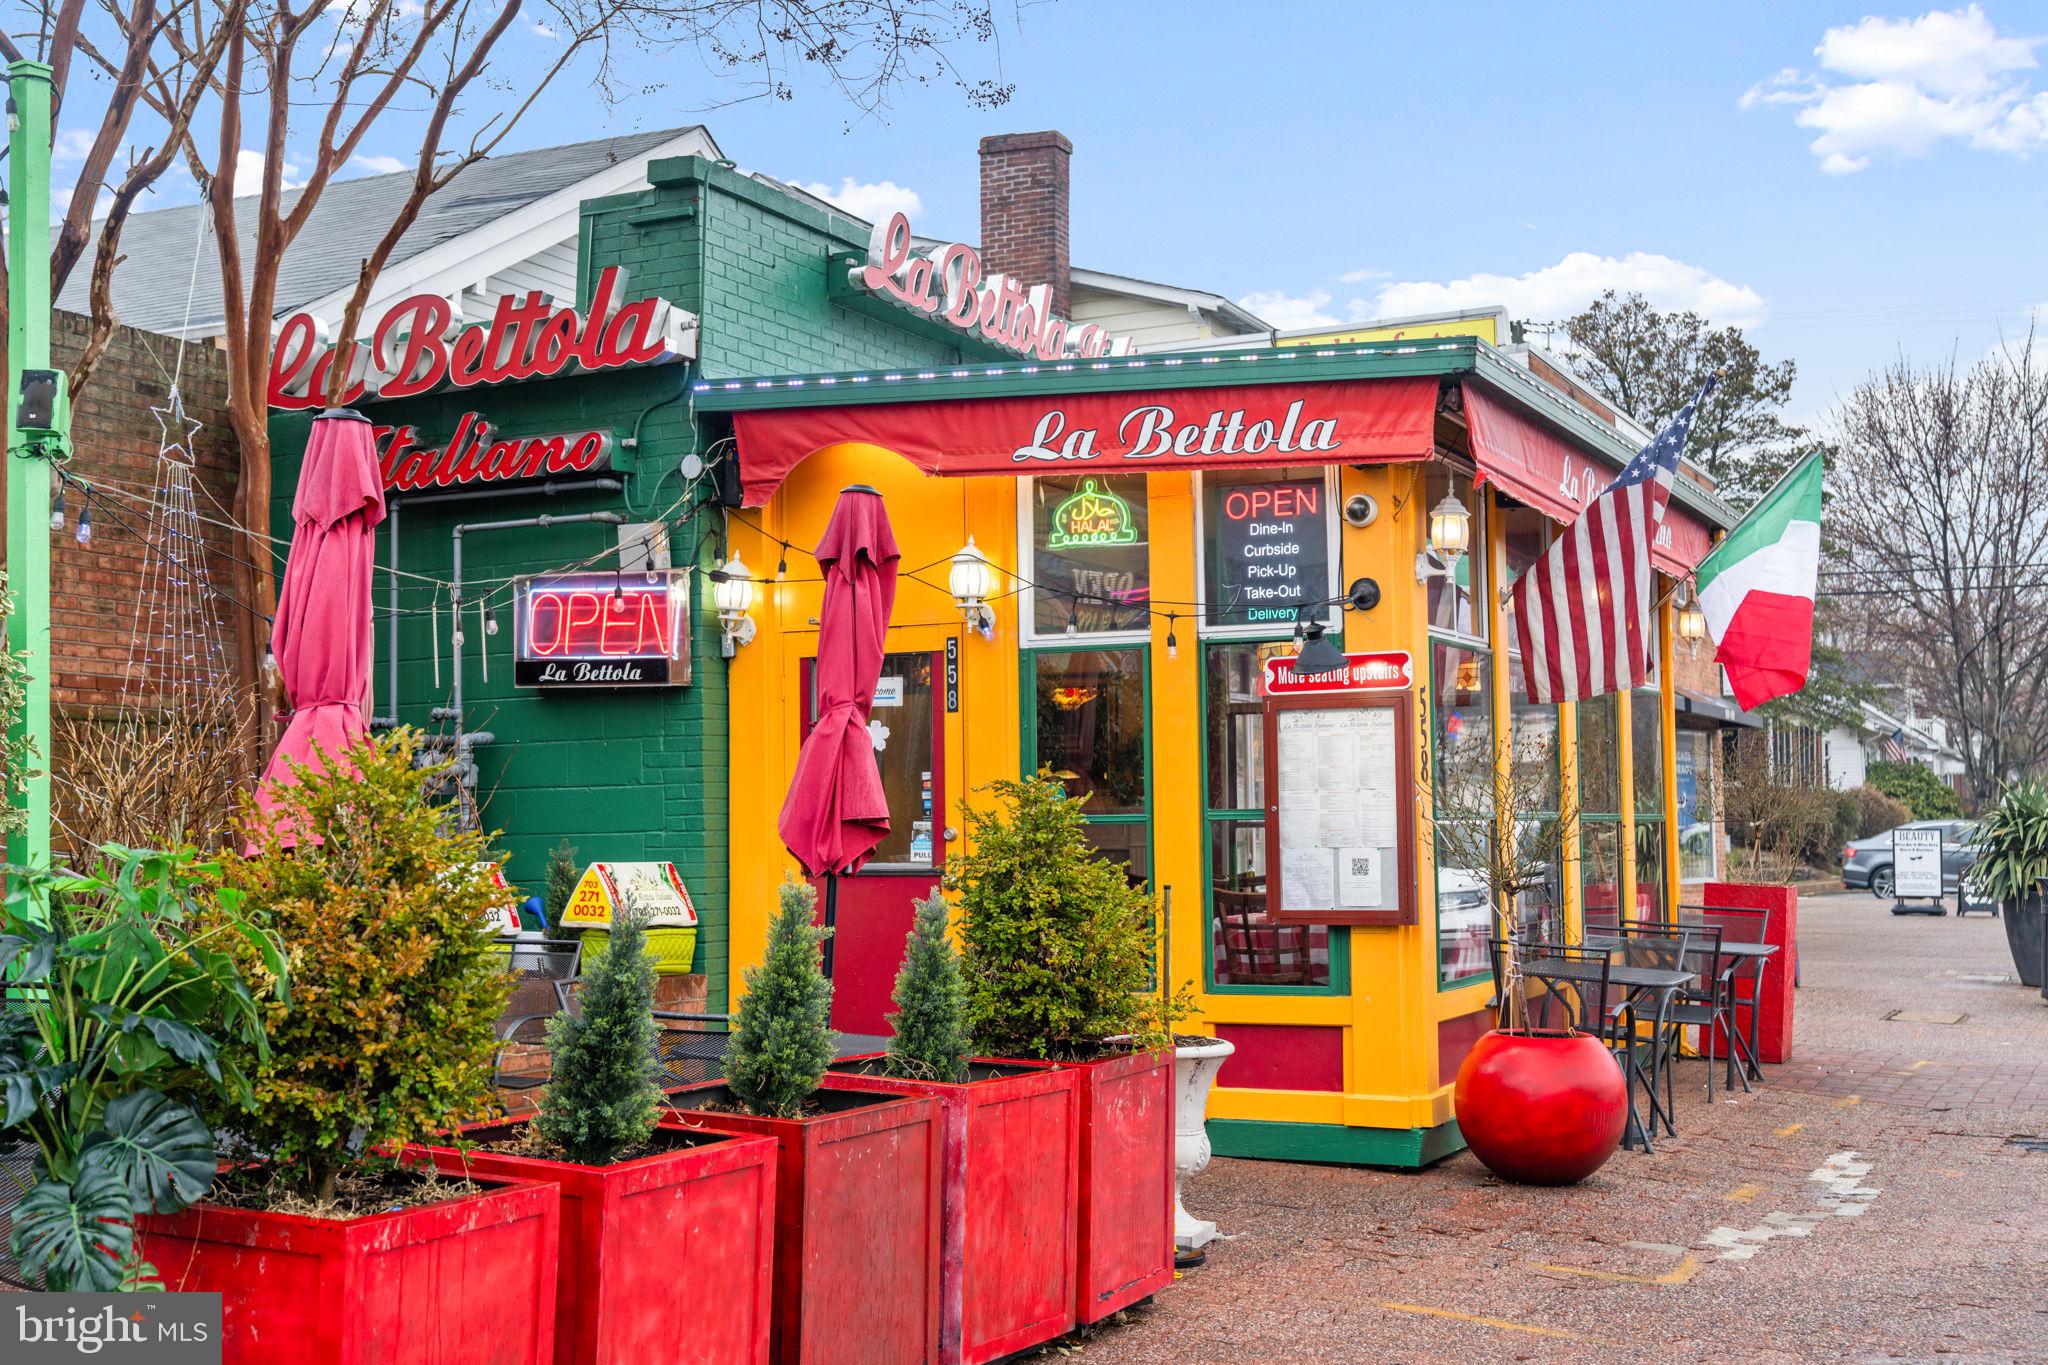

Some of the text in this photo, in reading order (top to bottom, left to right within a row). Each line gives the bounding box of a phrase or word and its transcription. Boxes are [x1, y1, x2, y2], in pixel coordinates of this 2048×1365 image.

[864, 211, 1068, 361] La Bettola
[267, 265, 666, 411] La Bettola
[1011, 399, 1341, 462] La Bettola
[372, 411, 603, 491] taliano
[1226, 487, 1318, 520] OPEN
[1249, 521, 1293, 536] Dine-In
[1244, 542, 1300, 557] Curbside
[1248, 563, 1297, 579] Pick-Up
[1244, 584, 1301, 600] Take-Out
[1248, 607, 1298, 621] Delivery
[530, 593, 669, 655] OPEN
[539, 662, 643, 682] La Bettola
[947, 641, 957, 709] 558
[1353, 661, 1399, 684] upstairs
[1419, 685, 1429, 783] 558
[1899, 832, 1935, 841] BEAUTY
[584, 881, 598, 889] 703
[580, 891, 600, 903] 271
[573, 905, 605, 918] 0032
[651, 906, 682, 917] 271-0032
